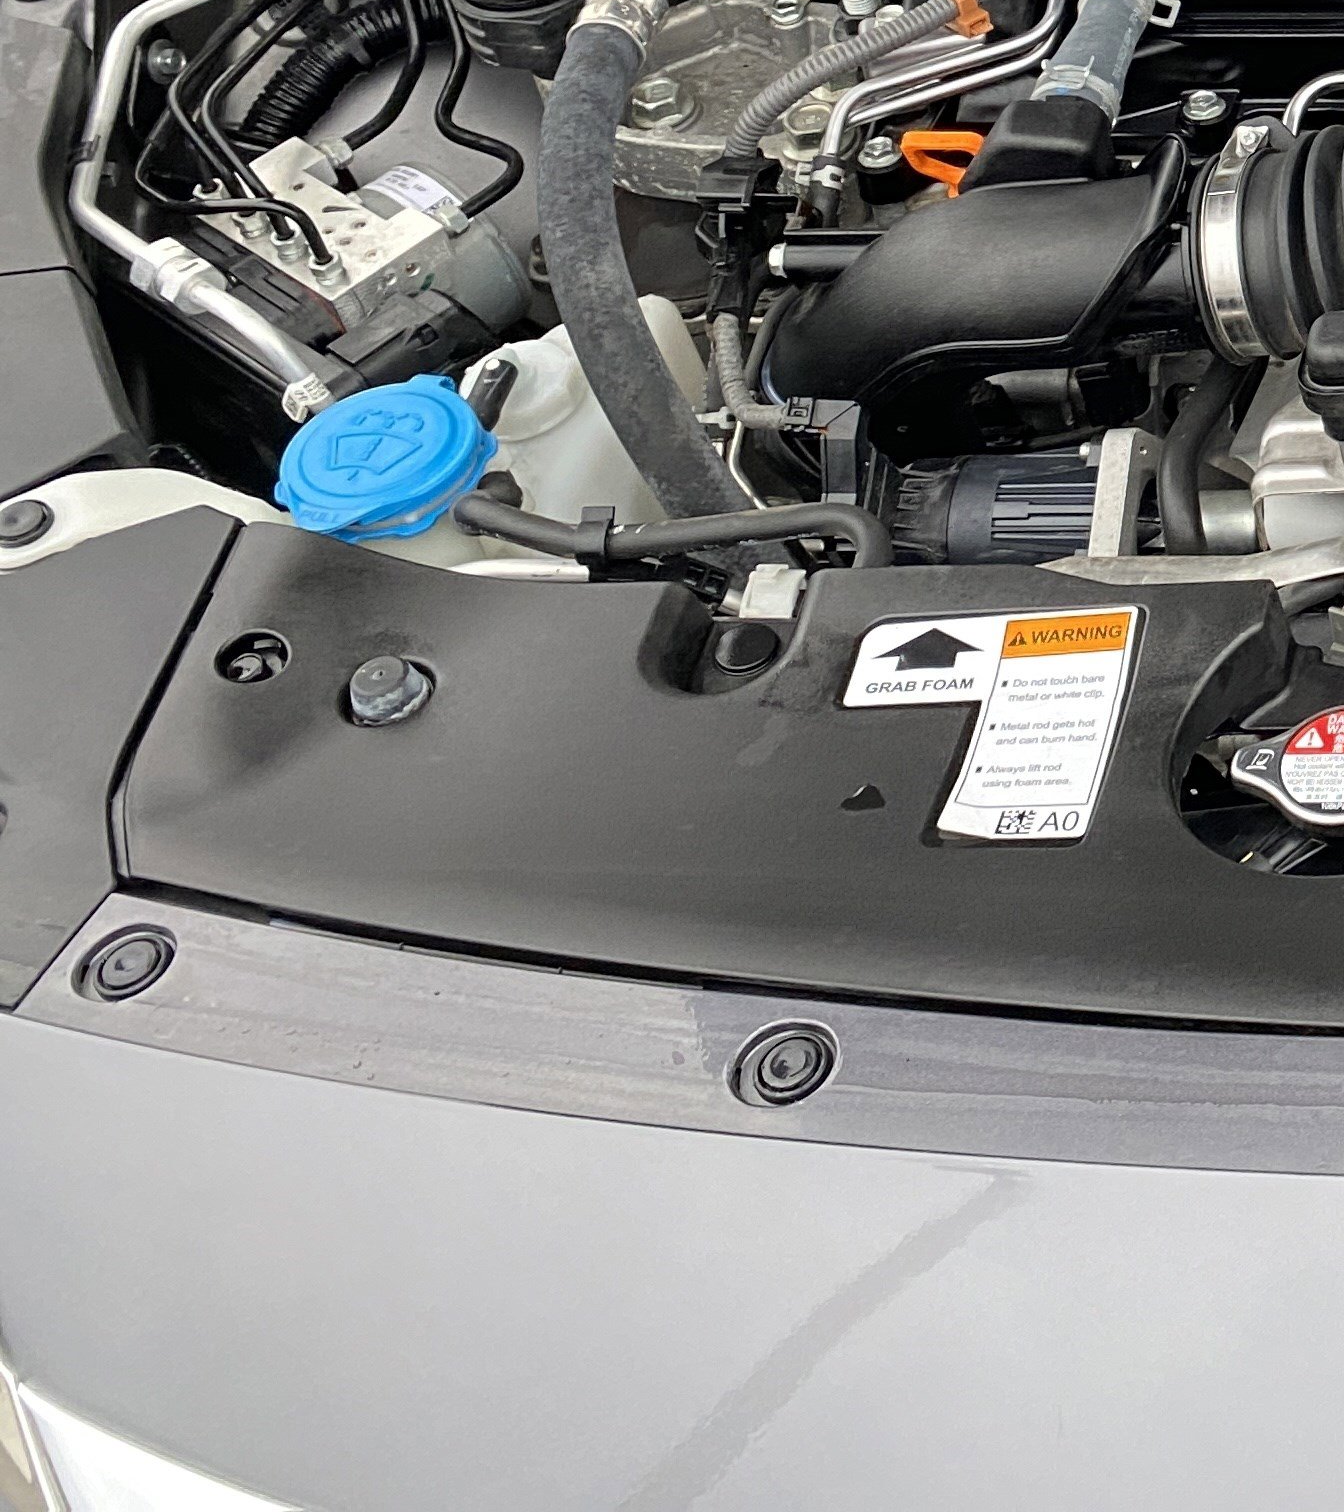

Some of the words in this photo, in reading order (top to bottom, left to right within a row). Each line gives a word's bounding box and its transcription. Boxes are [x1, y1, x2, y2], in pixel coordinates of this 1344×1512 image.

[301, 509, 340, 524] PULL
[1031, 624, 1123, 644] WARNING
[865, 681, 916, 694] GRAB
[921, 678, 975, 692] FOAM
[1013, 679, 1028, 688] Do
[1031, 677, 1048, 687] not
[1050, 675, 1079, 686] touch
[1081, 674, 1105, 684] bare
[1008, 692, 1038, 702] metal
[1040, 693, 1052, 701] or
[1054, 690, 1082, 700] white
[1000, 722, 1030, 731] Metal
[1032, 721, 1050, 729] rod
[1052, 720, 1075, 730] gets
[1077, 718, 1096, 727] hot
[996, 737, 1017, 745] and
[1018, 737, 1039, 745] can
[1067, 732, 1098, 743] hand.
[986, 764, 1026, 775] Always
[1027, 763, 1041, 772] lift
[1042, 763, 1062, 772] rod
[981, 779, 1012, 789] using
[1014, 777, 1042, 786] foam
[1037, 810, 1080, 833] A0
